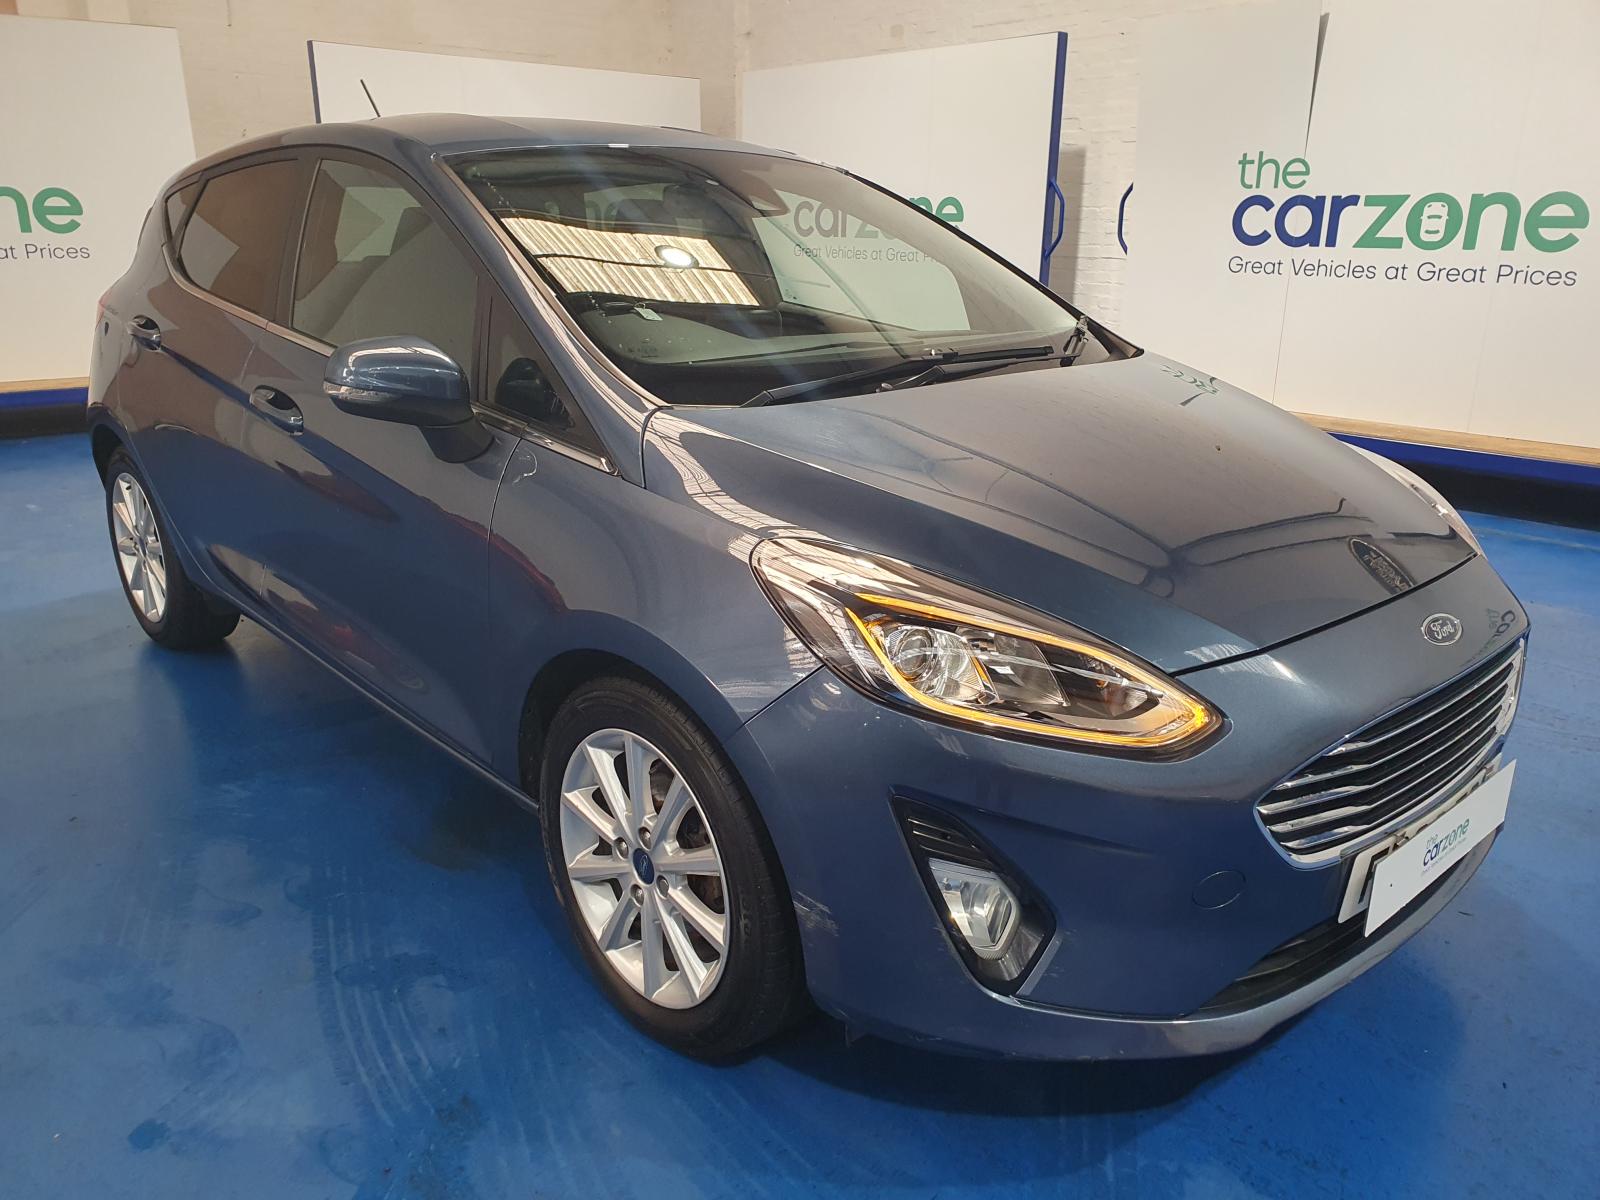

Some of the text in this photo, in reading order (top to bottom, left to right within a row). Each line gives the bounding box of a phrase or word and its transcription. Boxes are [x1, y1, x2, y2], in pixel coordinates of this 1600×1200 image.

[1238, 151, 1311, 189] the
[1232, 190, 1590, 253] carzone
[25, 243, 91, 260] Prices
[793, 243, 822, 258] Great
[825, 245, 868, 260] Vehicles
[871, 247, 882, 260] at
[886, 247, 920, 263] Great
[1228, 256, 1578, 287] Great Vehicles at Great Prices
[1430, 619, 1456, 640] Ford
[1423, 818, 1470, 867] carzone
